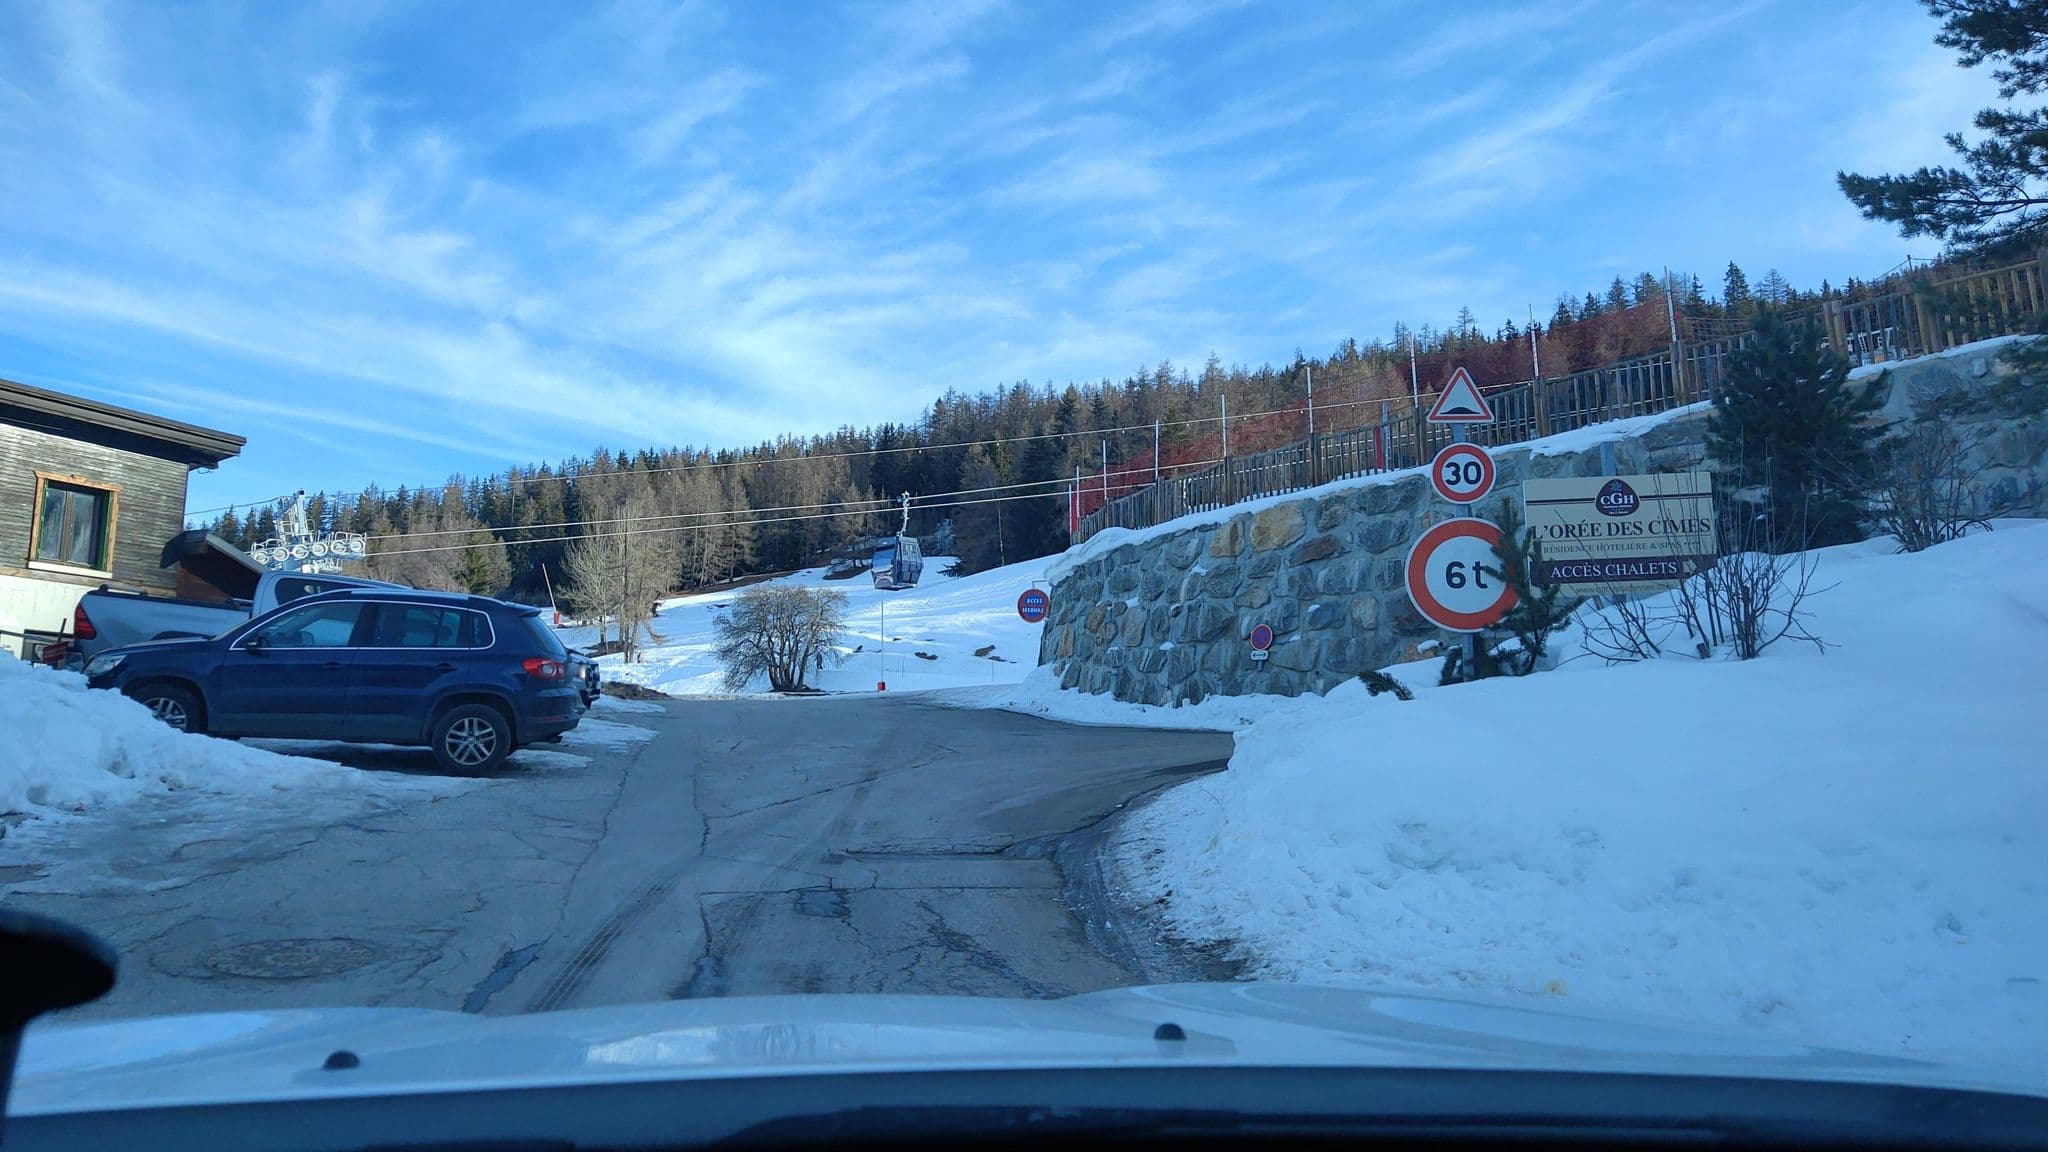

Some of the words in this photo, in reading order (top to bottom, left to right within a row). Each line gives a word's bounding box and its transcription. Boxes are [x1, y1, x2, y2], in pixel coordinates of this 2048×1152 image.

[1445, 461, 1482, 486] 30
[1600, 492, 1635, 505] CGH
[1606, 521, 1643, 537] DES
[1648, 517, 1711, 535] CIMES
[1550, 561, 1601, 578] ACCÈS
[1605, 561, 1678, 577] CHALETS
